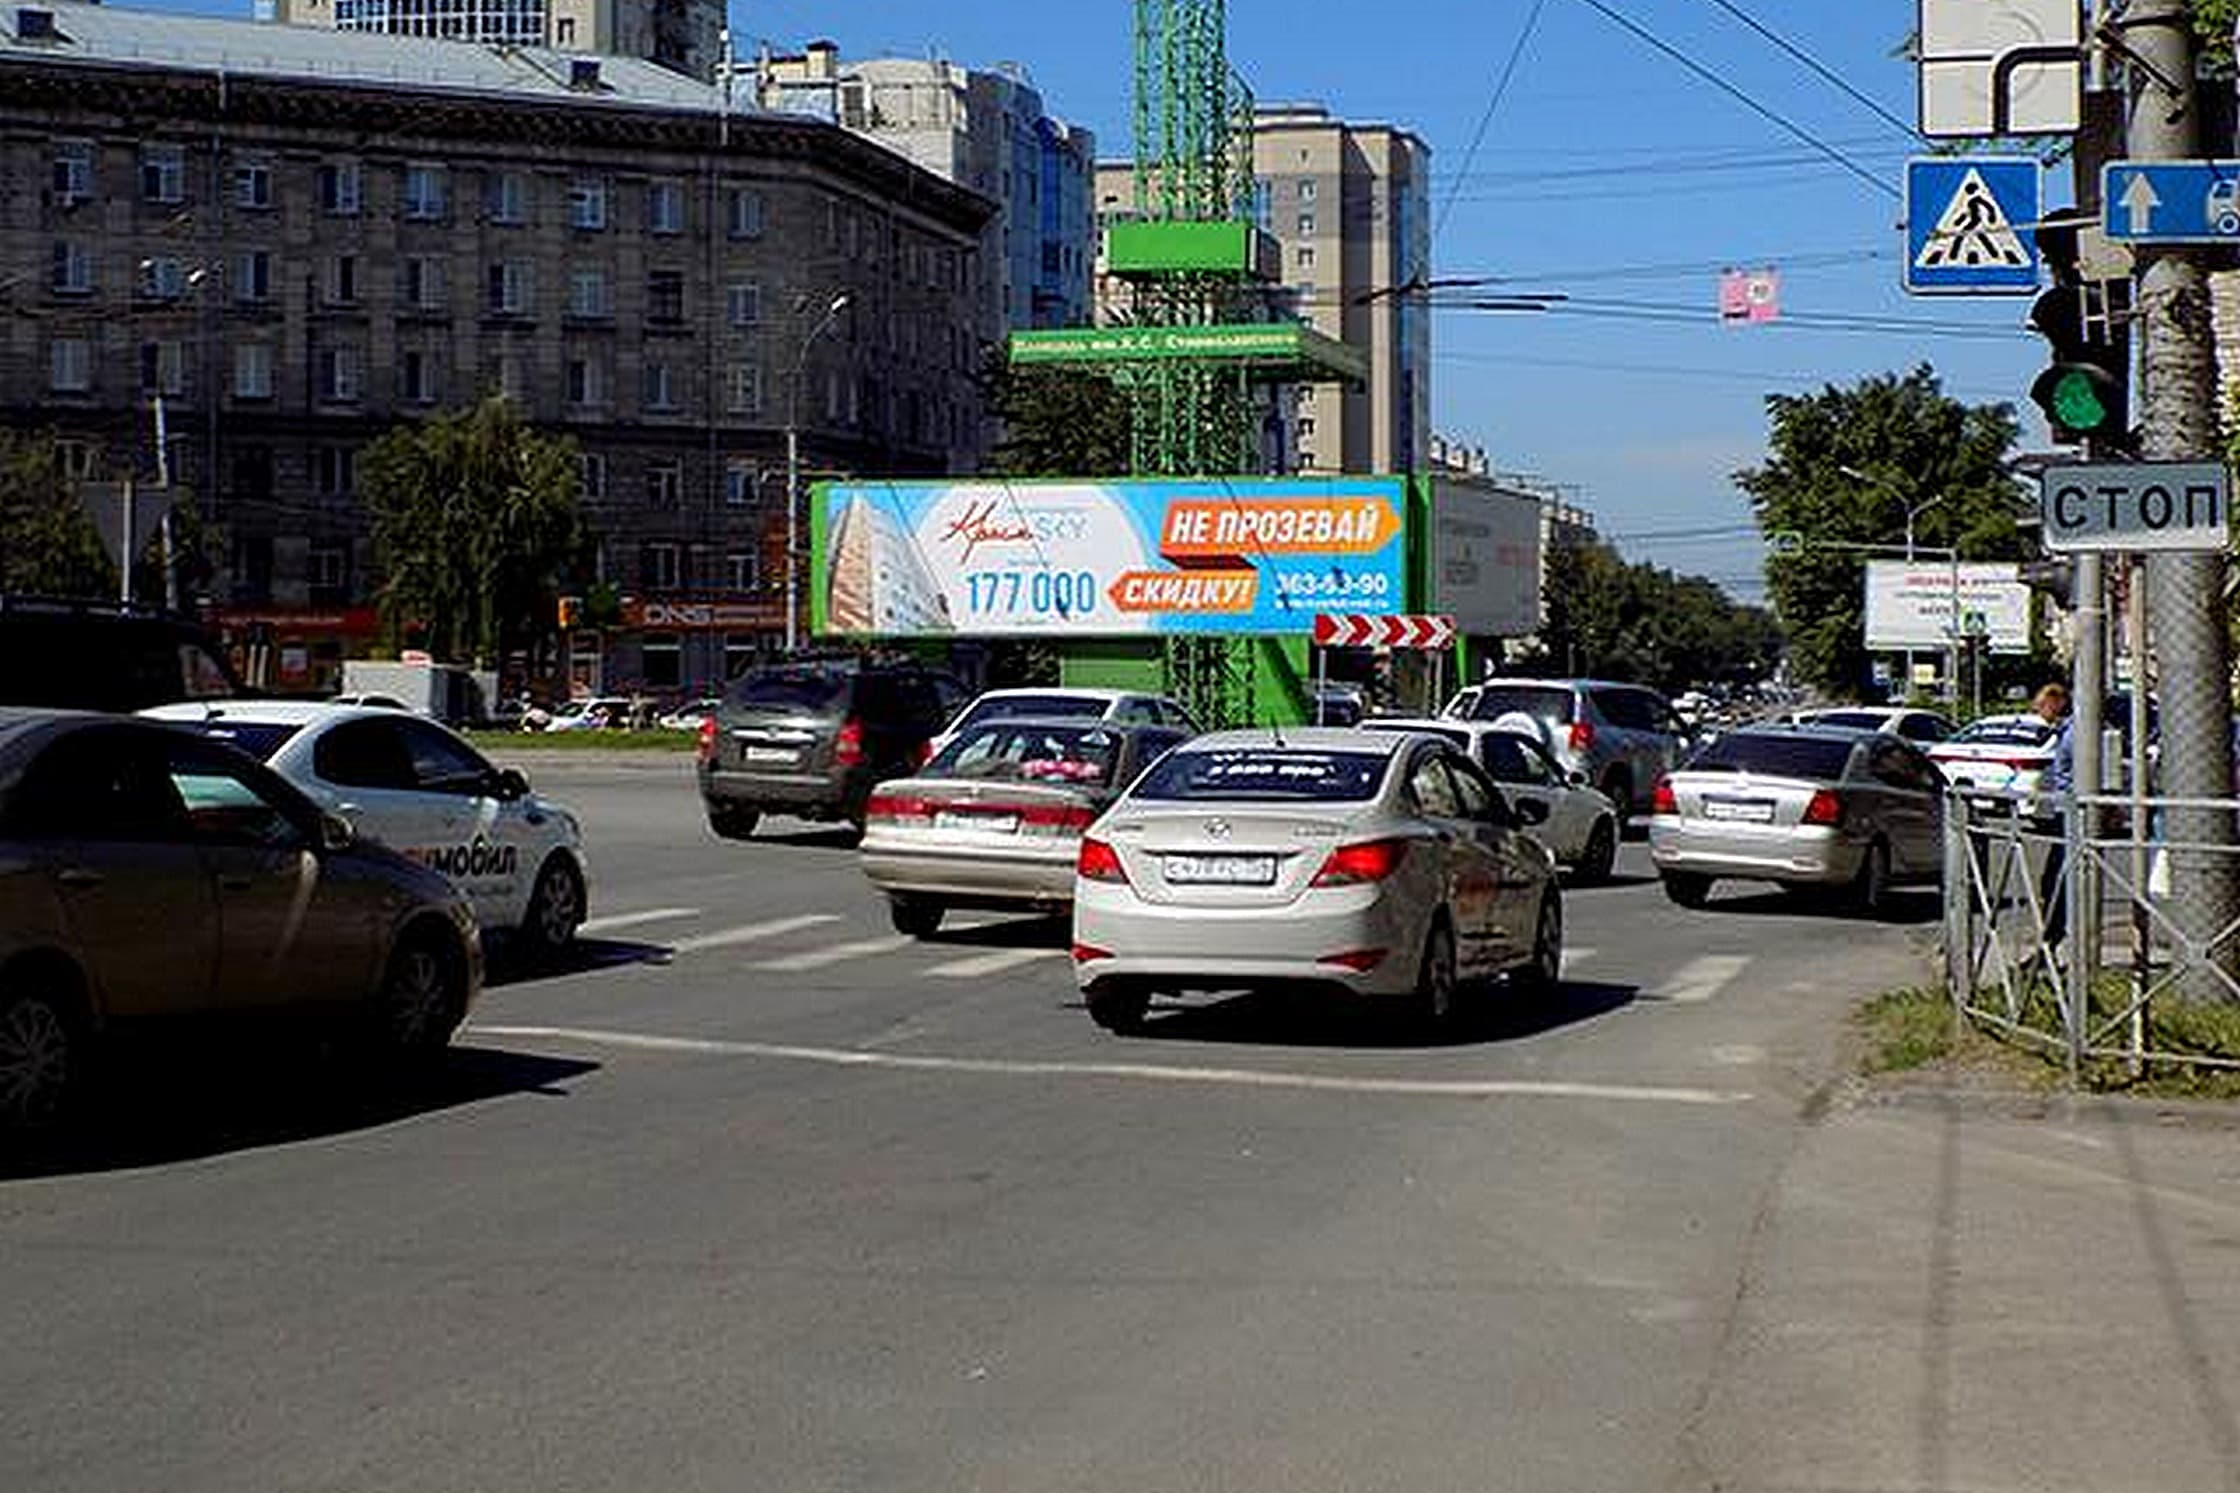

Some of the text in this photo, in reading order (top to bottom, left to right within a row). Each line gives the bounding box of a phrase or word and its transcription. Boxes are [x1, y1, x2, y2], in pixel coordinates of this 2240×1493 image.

[1169, 503, 1379, 543] НЕ ПРОЗЕВАЙ
[2055, 484, 2219, 529] СТОП
[966, 571, 1095, 614] 177 000
[1124, 577, 1252, 606] СКИДКУ!
